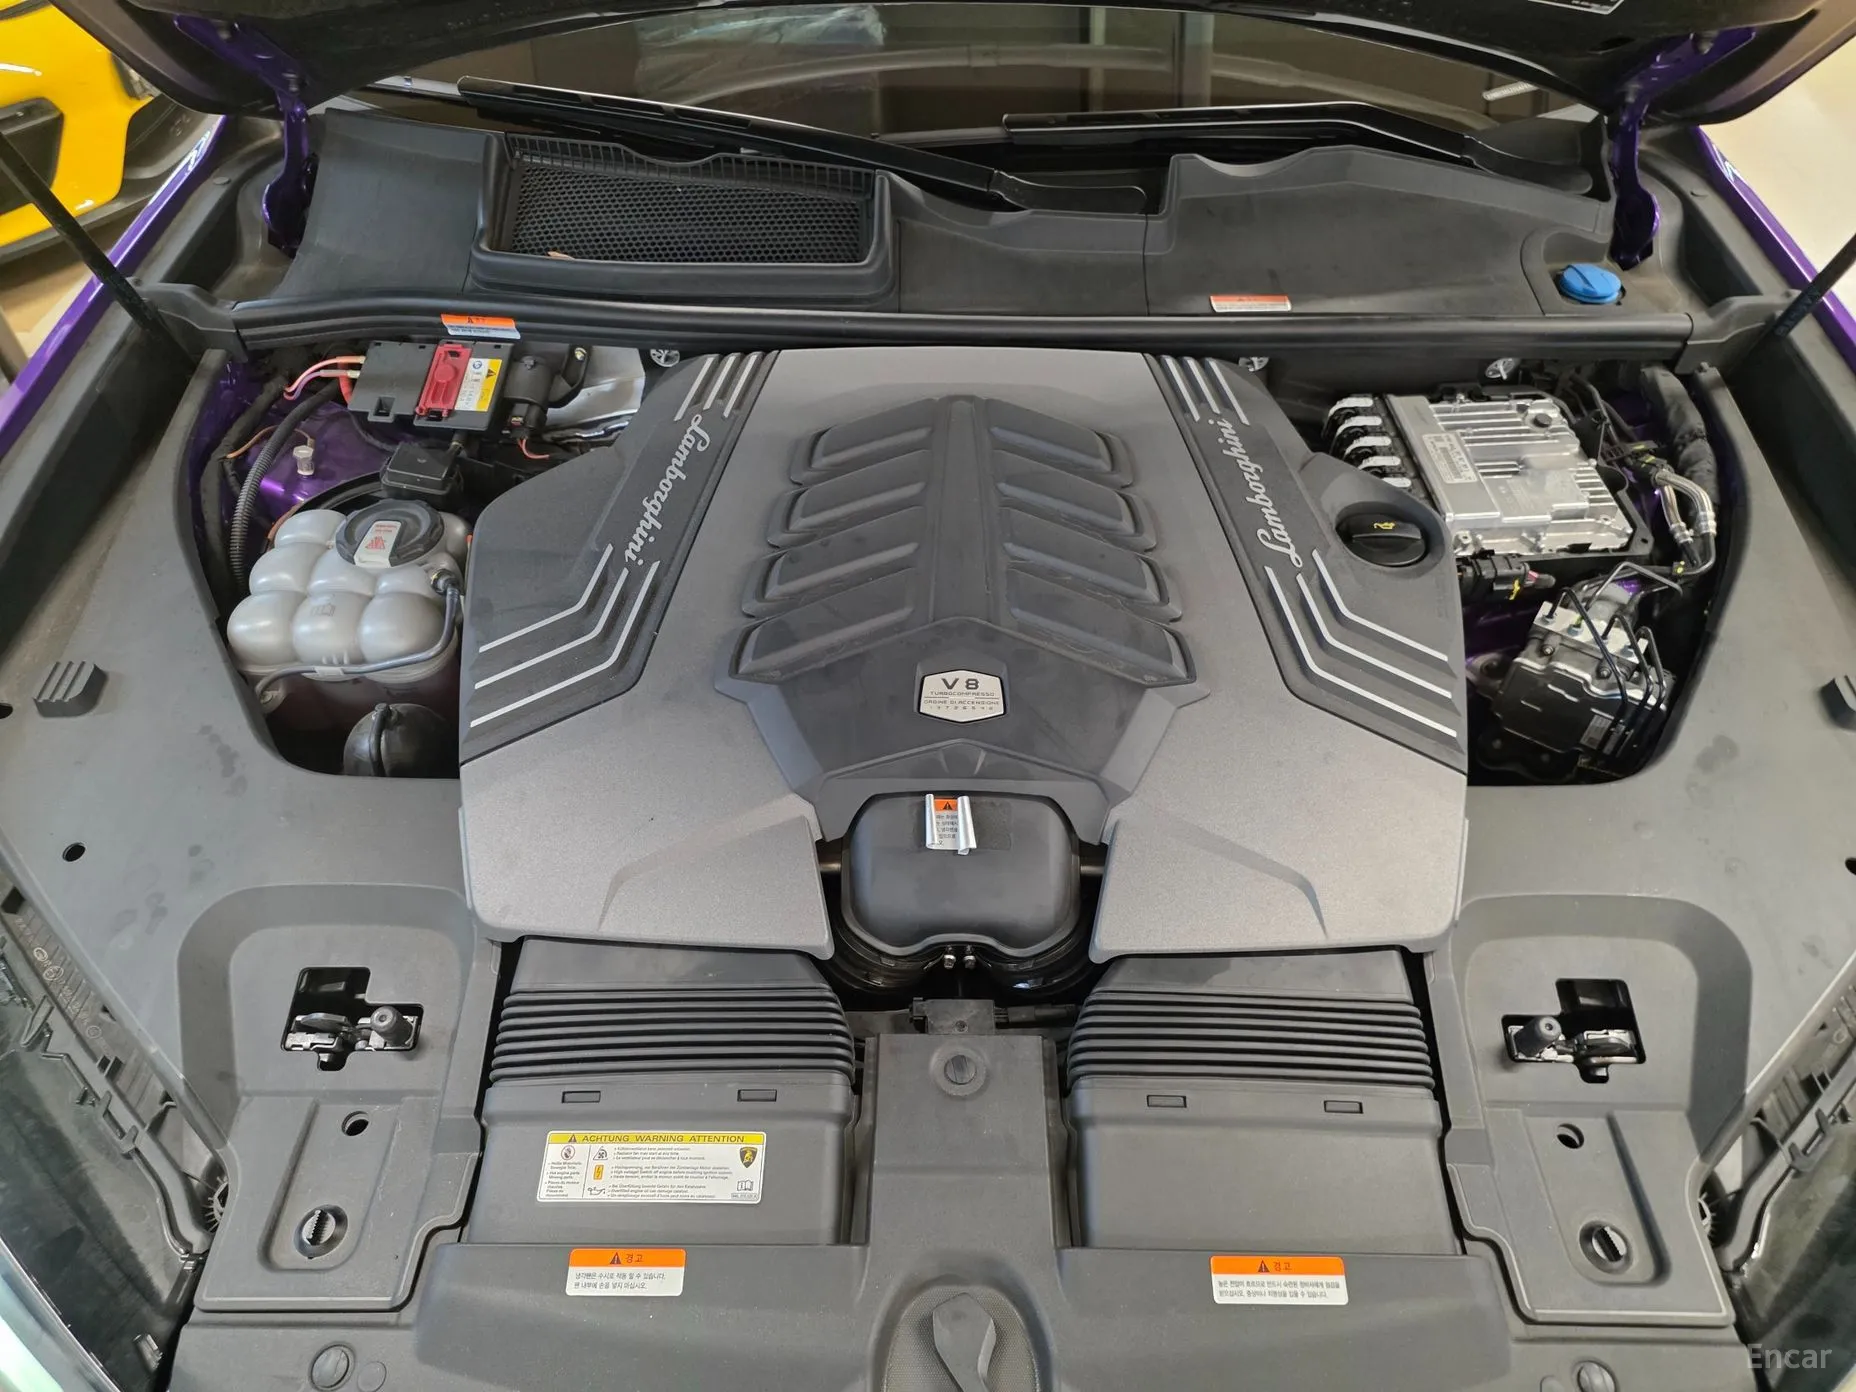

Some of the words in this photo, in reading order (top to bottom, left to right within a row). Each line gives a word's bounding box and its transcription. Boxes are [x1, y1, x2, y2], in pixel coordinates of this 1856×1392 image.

[625, 414, 710, 566] Lamborghini
[1208, 418, 1303, 568] Lamborghini
[689, 1135, 745, 1143] ATTENTION
[625, 1253, 643, 1264] 경고
[1273, 1261, 1292, 1272] 경고
